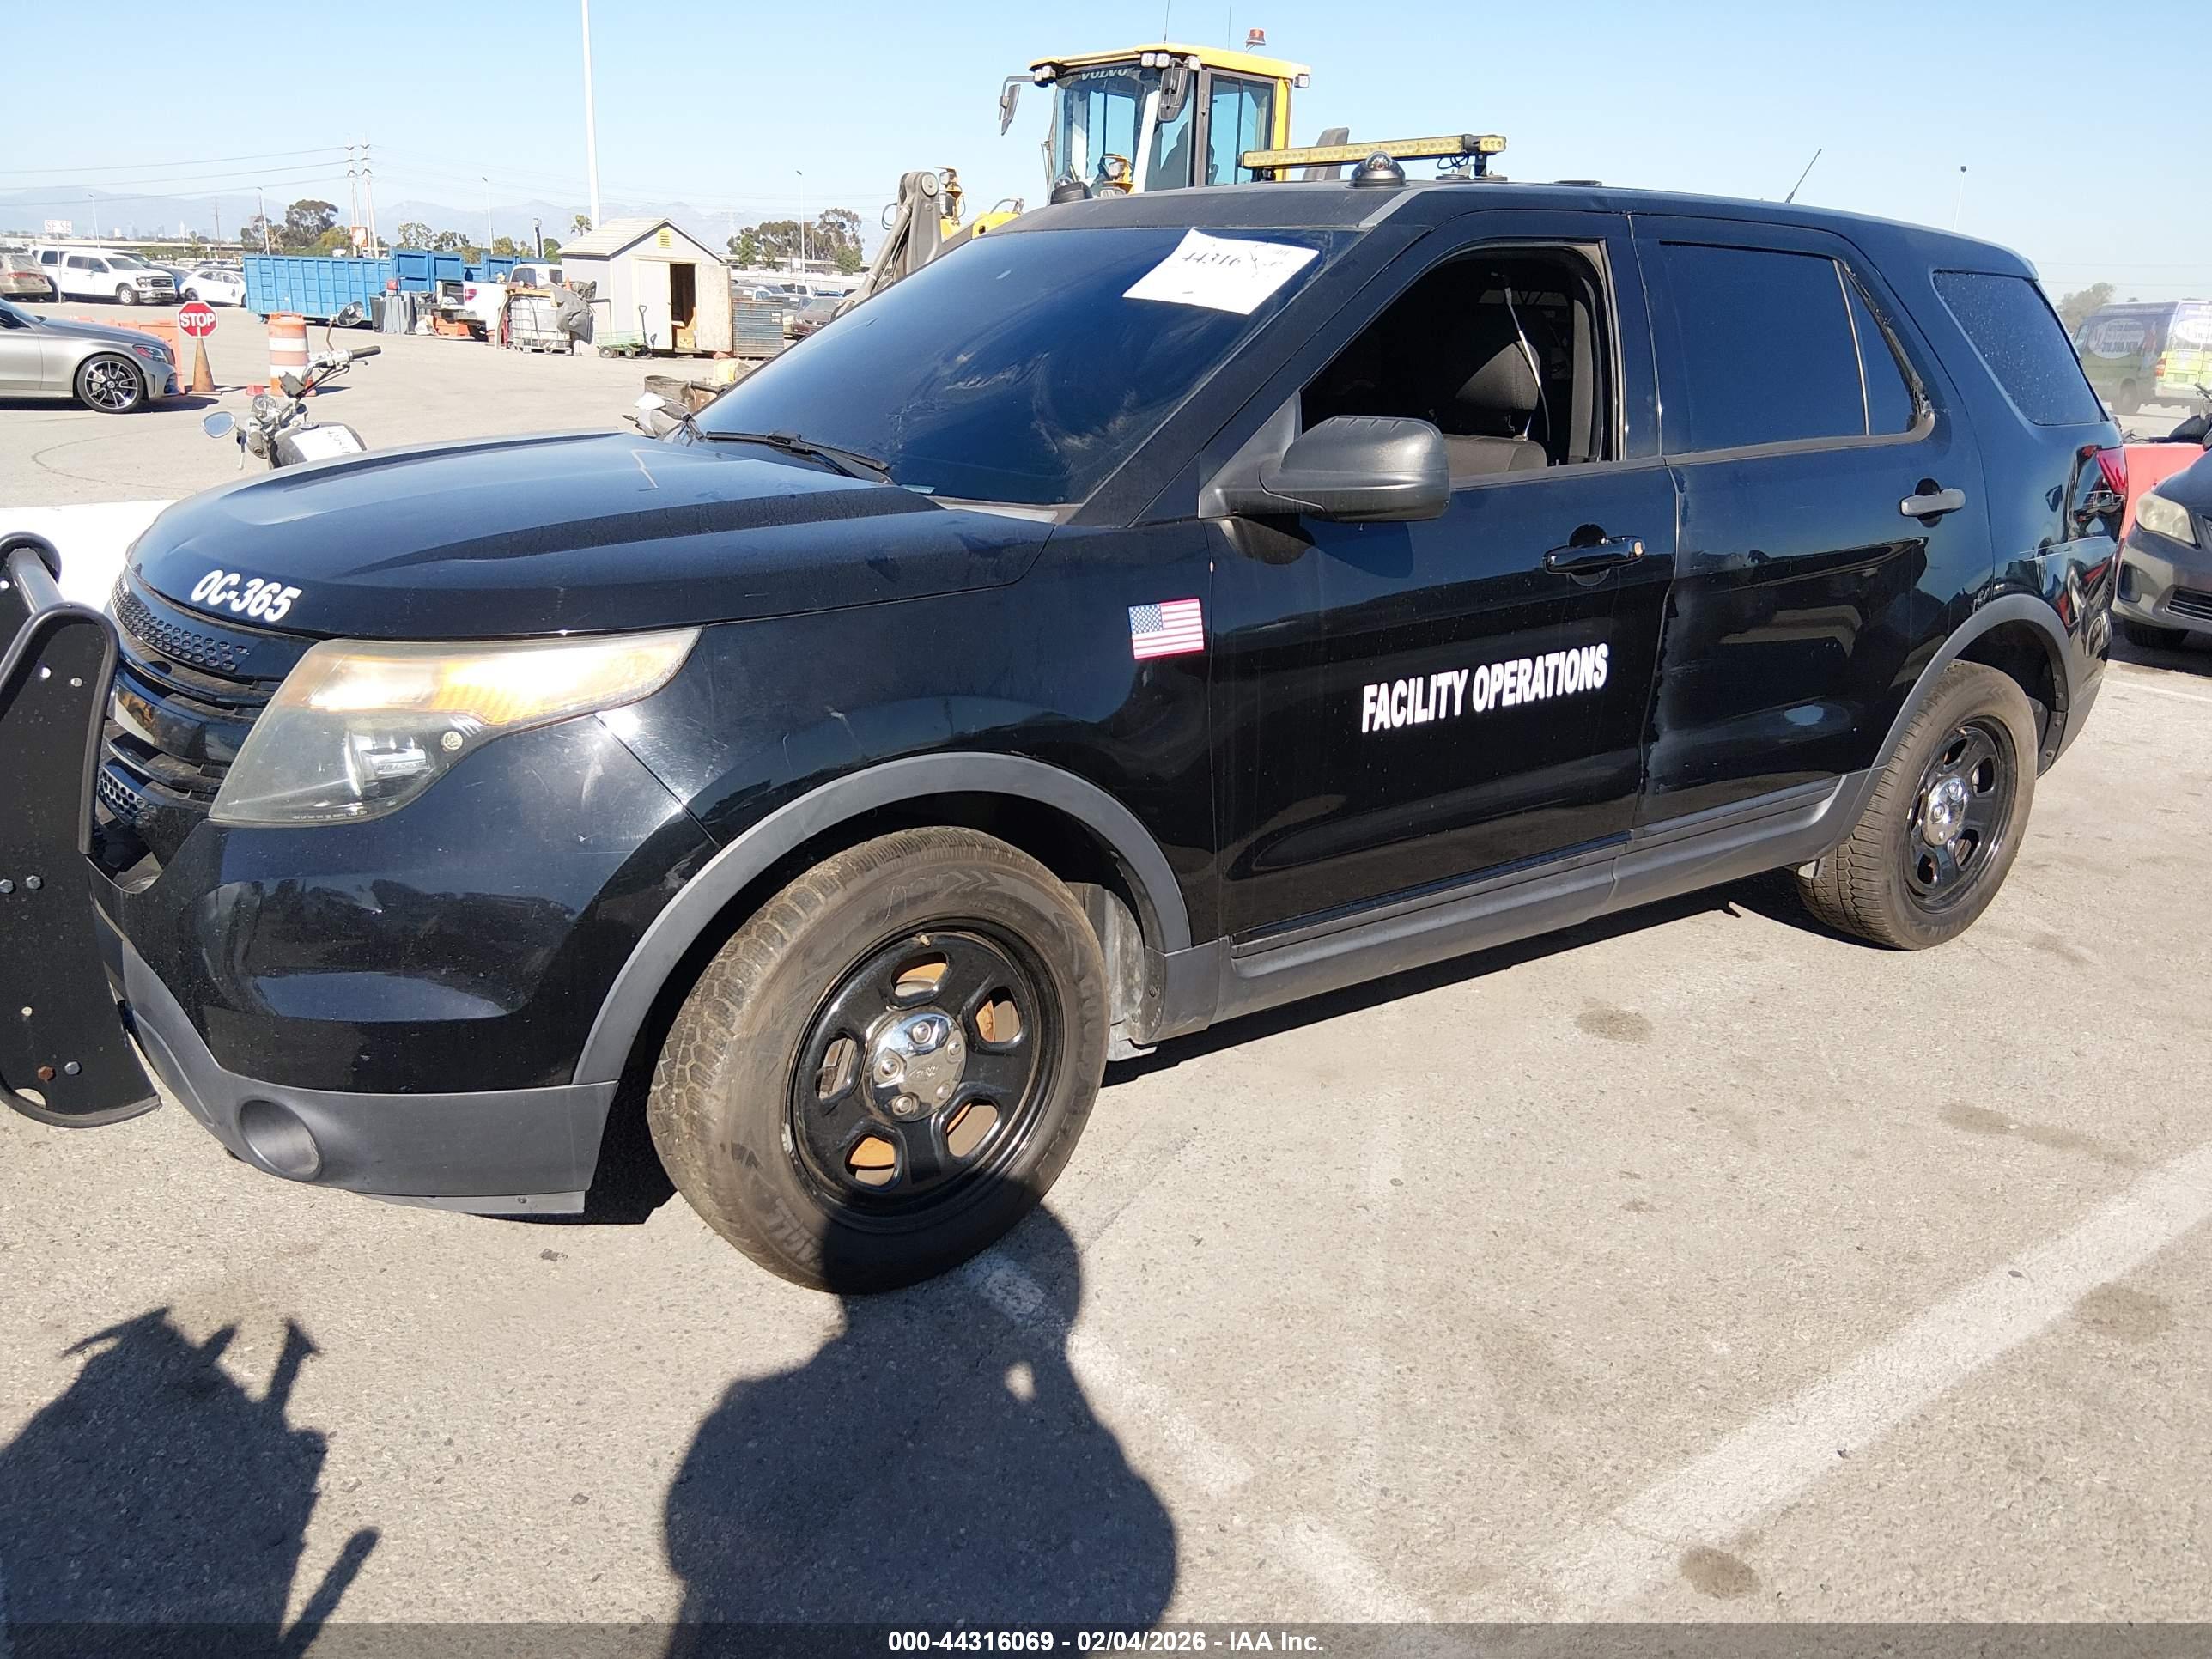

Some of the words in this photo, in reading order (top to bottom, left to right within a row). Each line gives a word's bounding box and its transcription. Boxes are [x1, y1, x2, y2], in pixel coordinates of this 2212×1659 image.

[1081, 69, 1127, 81] VOLVO
[179, 313, 216, 328] STOP
[190, 569, 302, 623] OC-365
[1361, 669, 1469, 733] FACILITY
[1473, 643, 1609, 713] OPERATIONS
